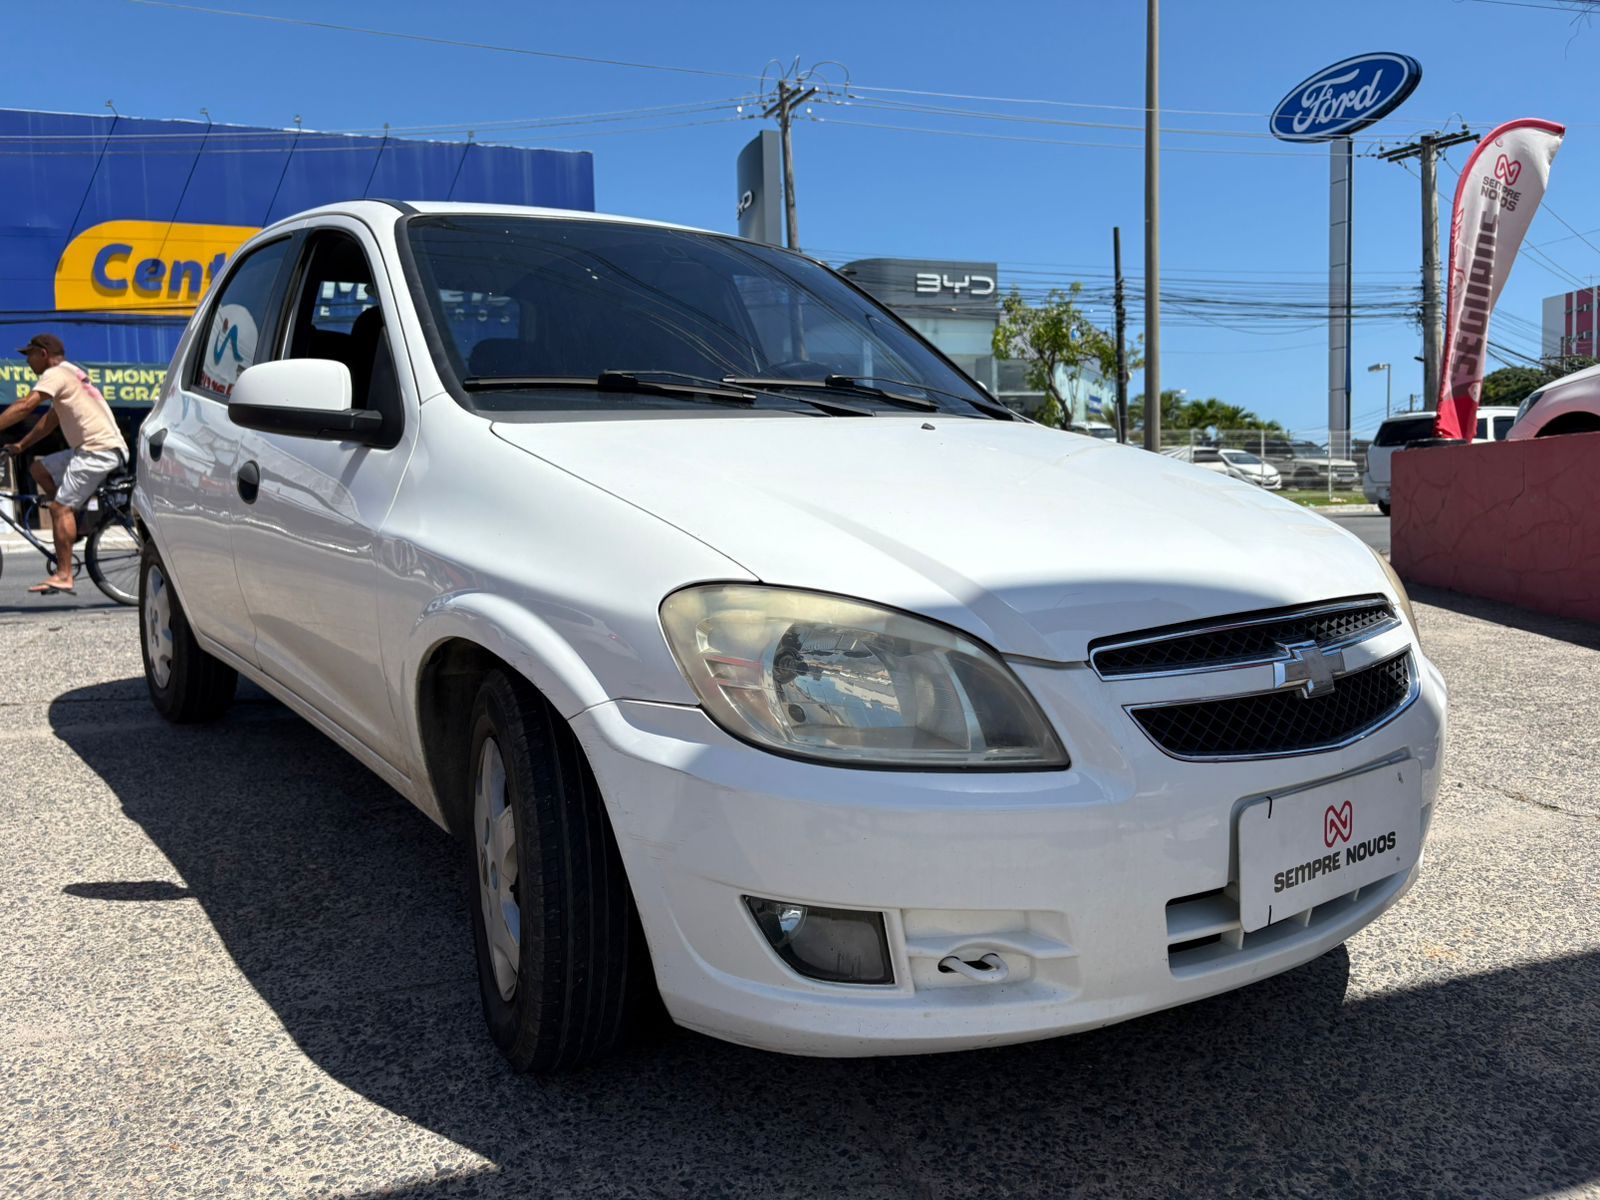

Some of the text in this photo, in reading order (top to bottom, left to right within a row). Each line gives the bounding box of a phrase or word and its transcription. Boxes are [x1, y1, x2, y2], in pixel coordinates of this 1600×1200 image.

[1293, 68, 1383, 132] Ford
[916, 273, 995, 295] BYD
[1274, 831, 1396, 893] SEMPRE NOVOS
